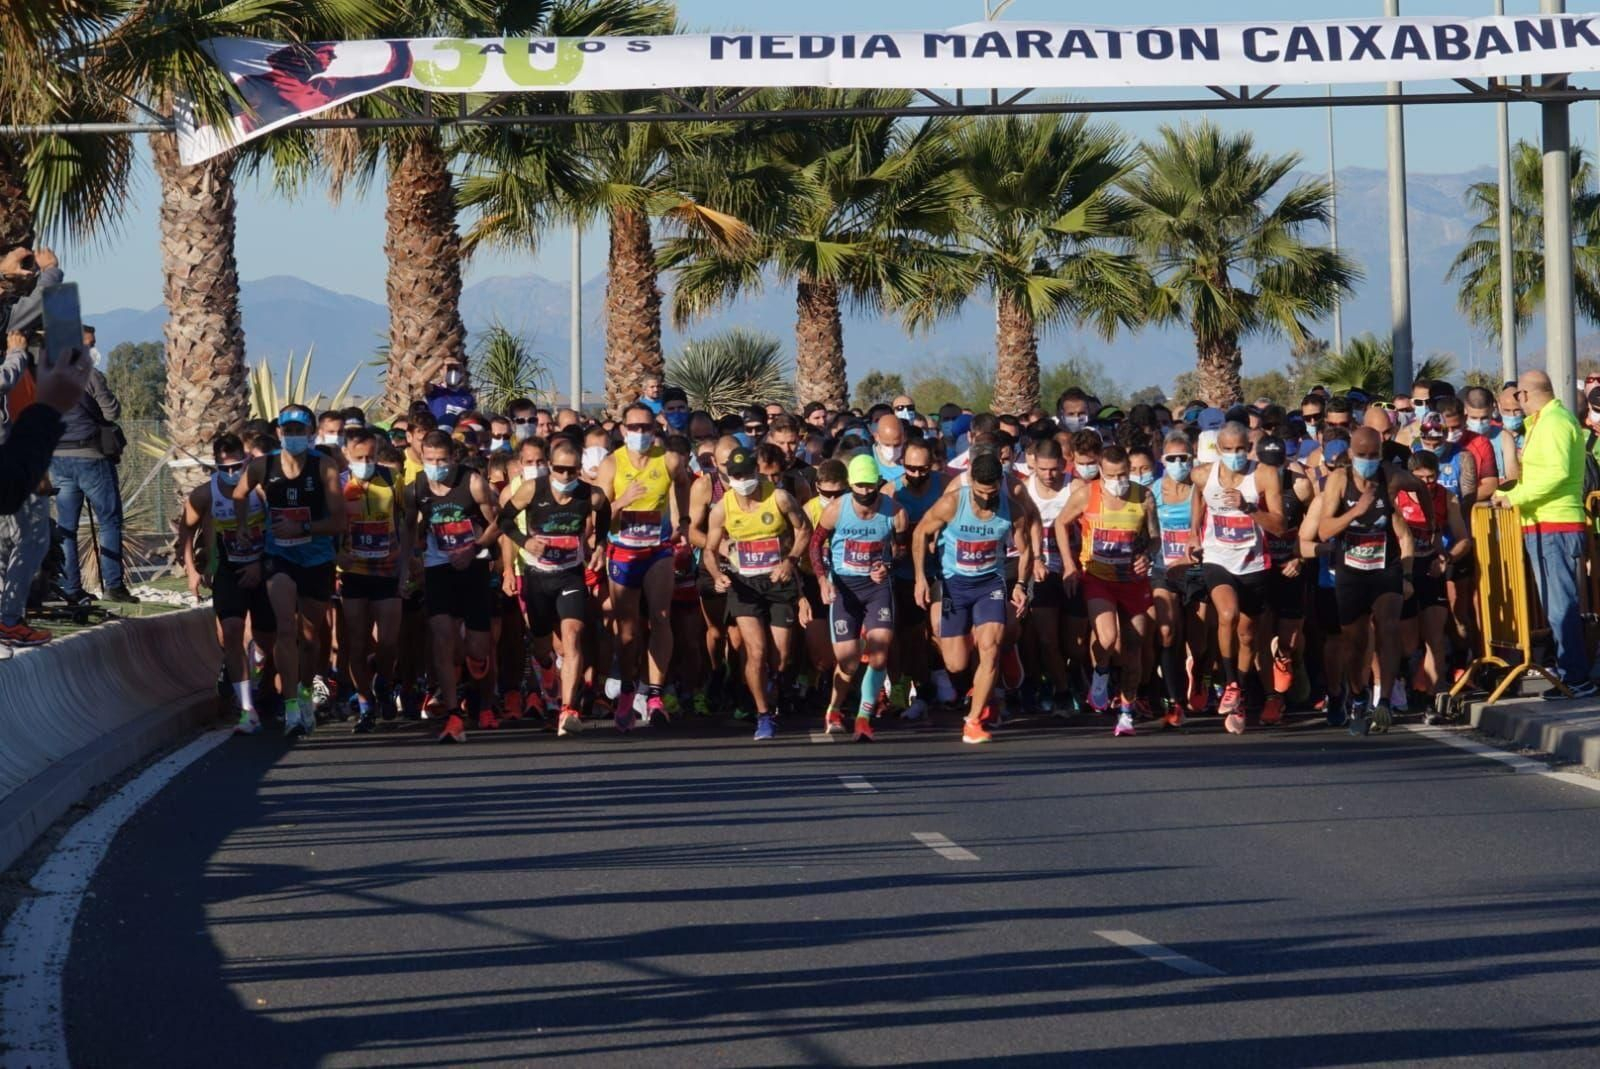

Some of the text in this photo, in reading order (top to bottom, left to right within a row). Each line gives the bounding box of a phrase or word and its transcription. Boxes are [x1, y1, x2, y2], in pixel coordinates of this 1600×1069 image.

[710, 34, 901, 60] MEDIA
[1242, 18, 1600, 62] CAIXABANK
[842, 527, 876, 537] nerja
[960, 525, 994, 536] nerja
[360, 535, 373, 545] 18
[443, 535, 457, 545] 15
[1102, 541, 1116, 551] 77
[545, 549, 561, 559] 45
[745, 551, 765, 562] 167
[850, 552, 870, 562] 166
[962, 551, 982, 561] 246
